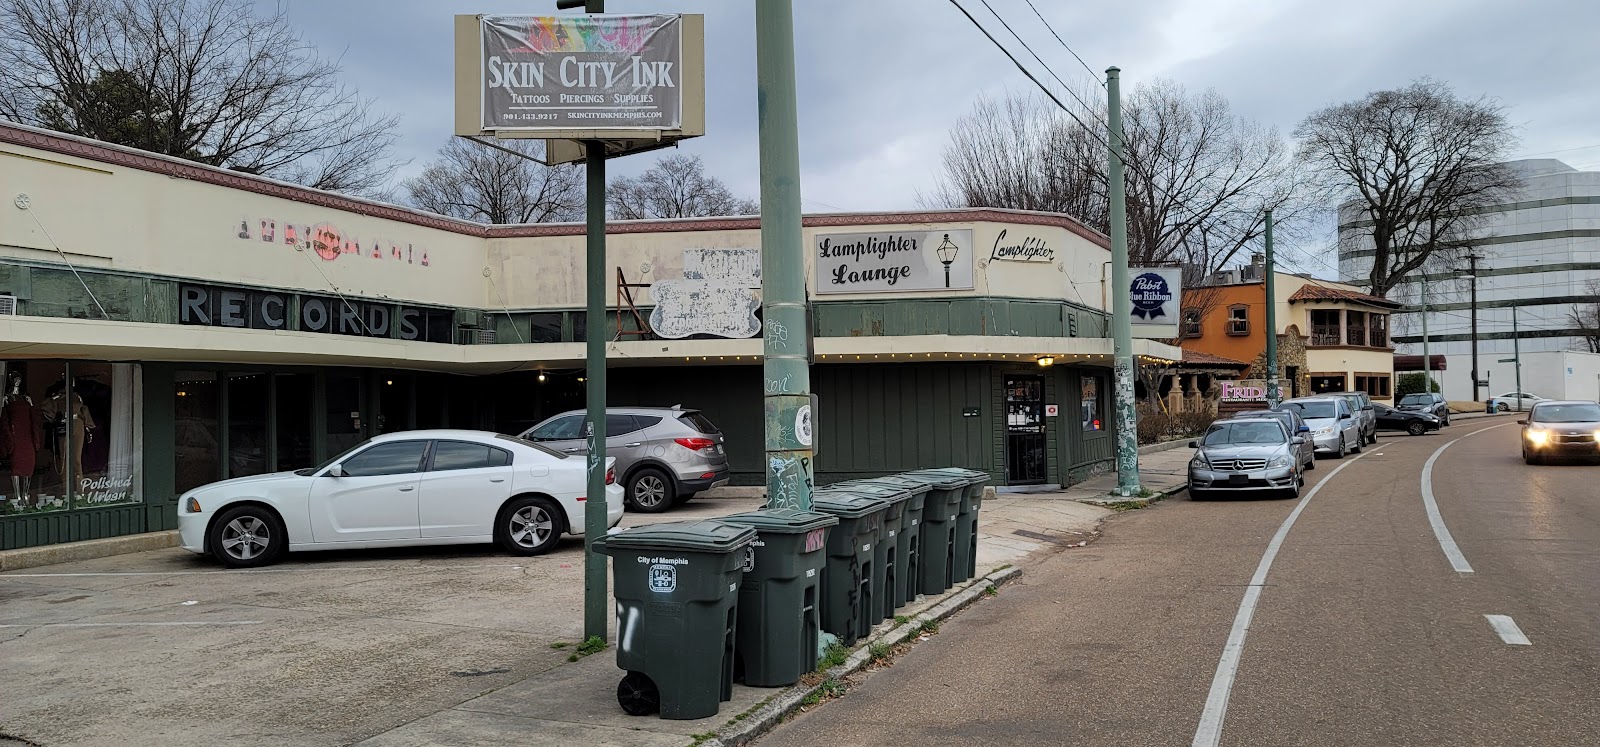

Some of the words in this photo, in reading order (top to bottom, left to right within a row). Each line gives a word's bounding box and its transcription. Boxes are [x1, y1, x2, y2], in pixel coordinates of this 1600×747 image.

[488, 55, 544, 89] SKIN
[559, 55, 617, 89] CITY
[631, 55, 675, 88] INK
[510, 93, 550, 104] TATTOOS
[559, 93, 604, 103] PIERCINGS
[613, 93, 654, 104] SUPPLIES
[503, 112, 558, 120] 901.433.9217
[819, 235, 917, 261] Lamplighter
[988, 229, 1055, 263] Lamplighter
[832, 265, 911, 285] Lounge
[1135, 277, 1162, 290] Pabst
[1143, 291, 1171, 300] Ribbon
[181, 285, 420, 340] RECORDS
[80, 474, 133, 493] Polished
[87, 490, 126, 504] Urban
[637, 556, 651, 565] City
[651, 556, 659, 564] of
[659, 557, 689, 565] Memphis
